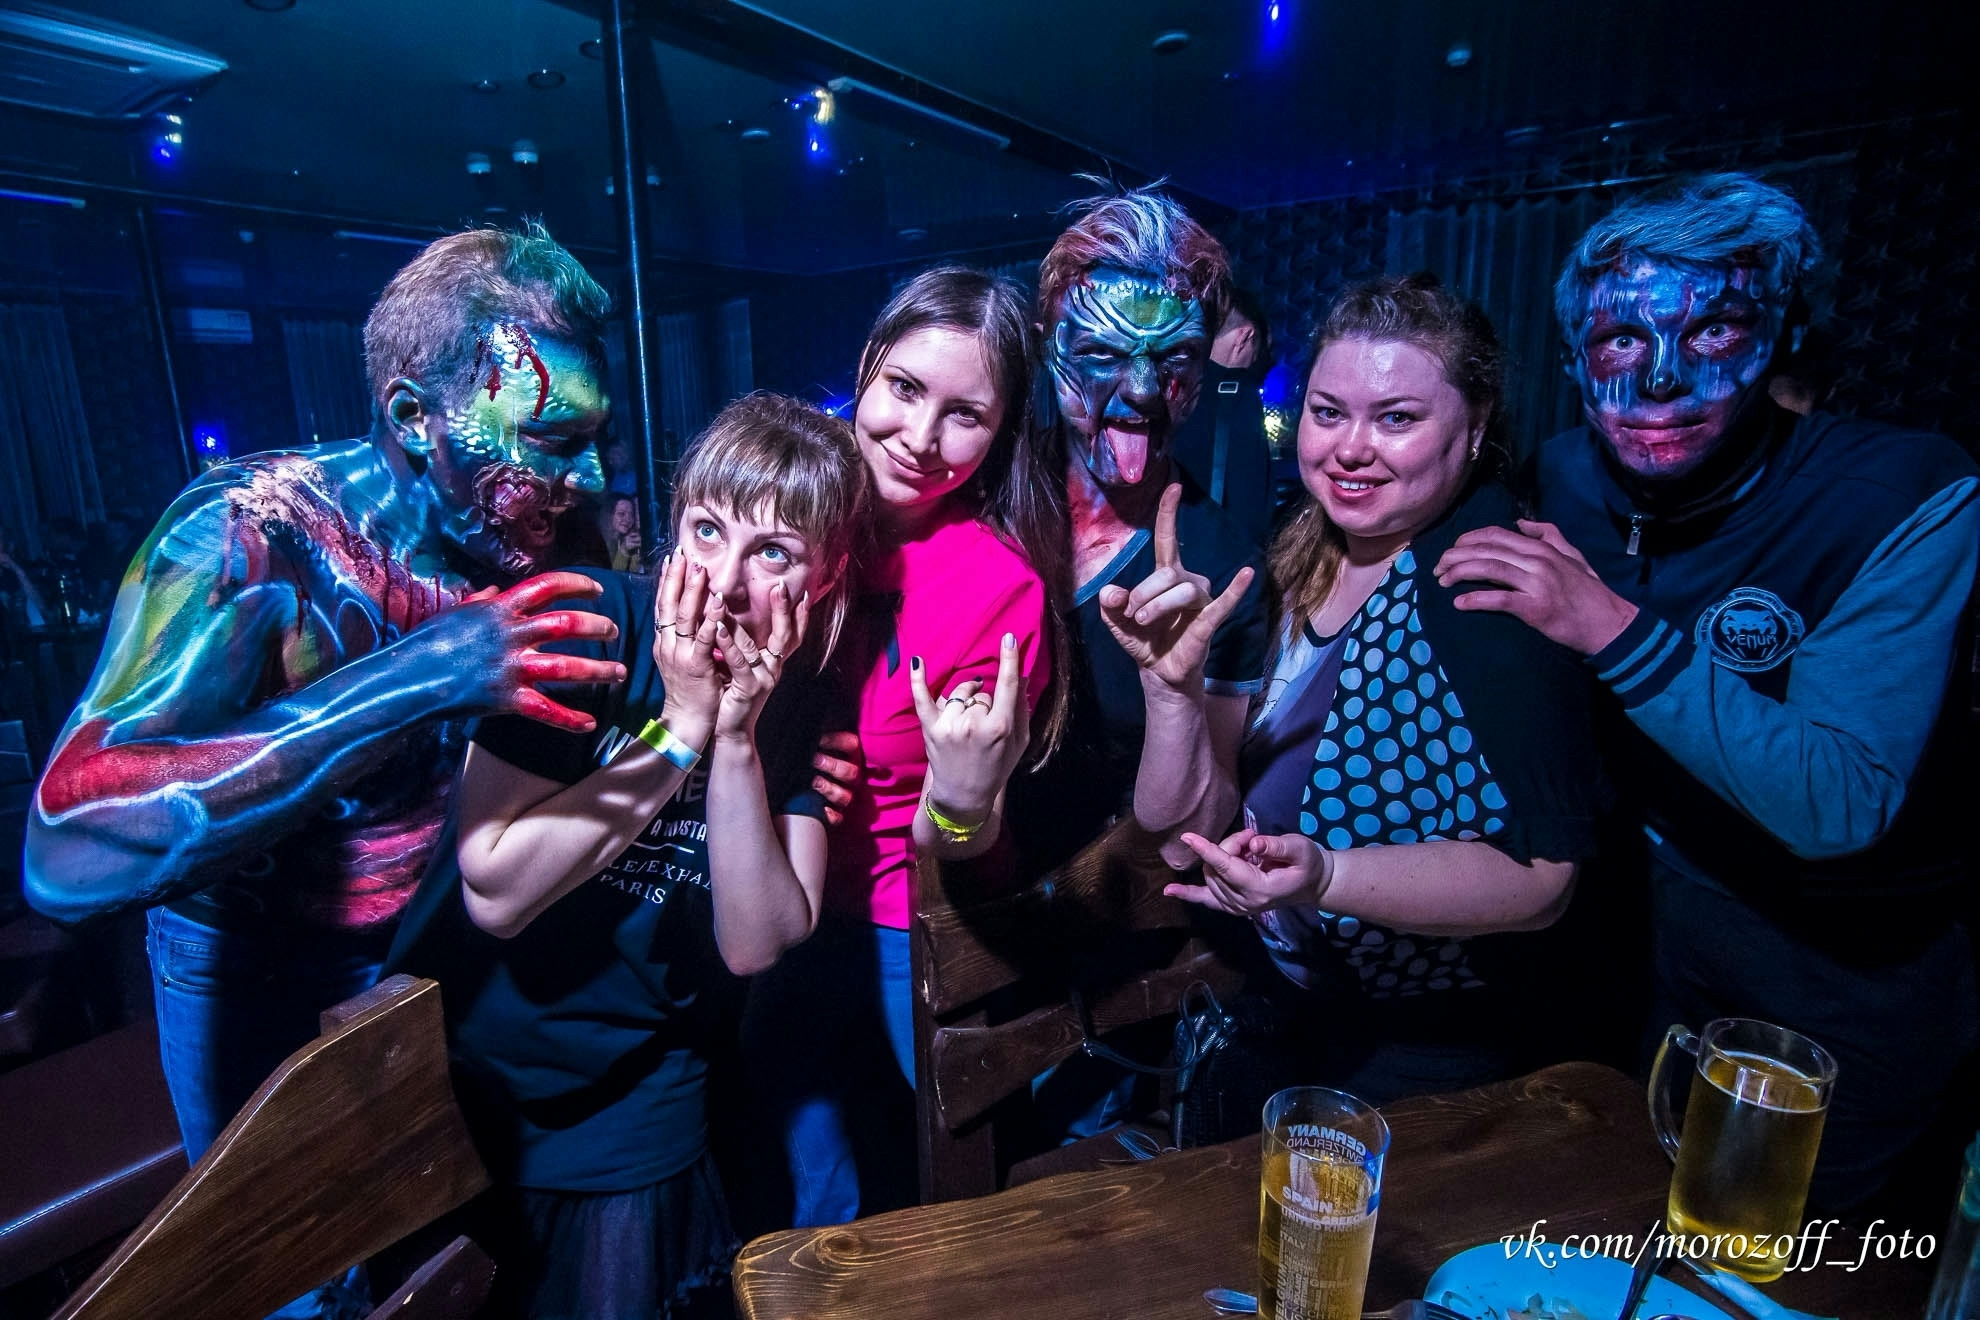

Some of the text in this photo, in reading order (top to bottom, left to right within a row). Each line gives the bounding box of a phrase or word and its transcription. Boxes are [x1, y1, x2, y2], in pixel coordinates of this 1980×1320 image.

[1726, 634, 1777, 650] VENUM
[663, 819, 708, 842] MISTA
[599, 873, 667, 904] PARIS
[1282, 1186, 1333, 1214] SPAIN
